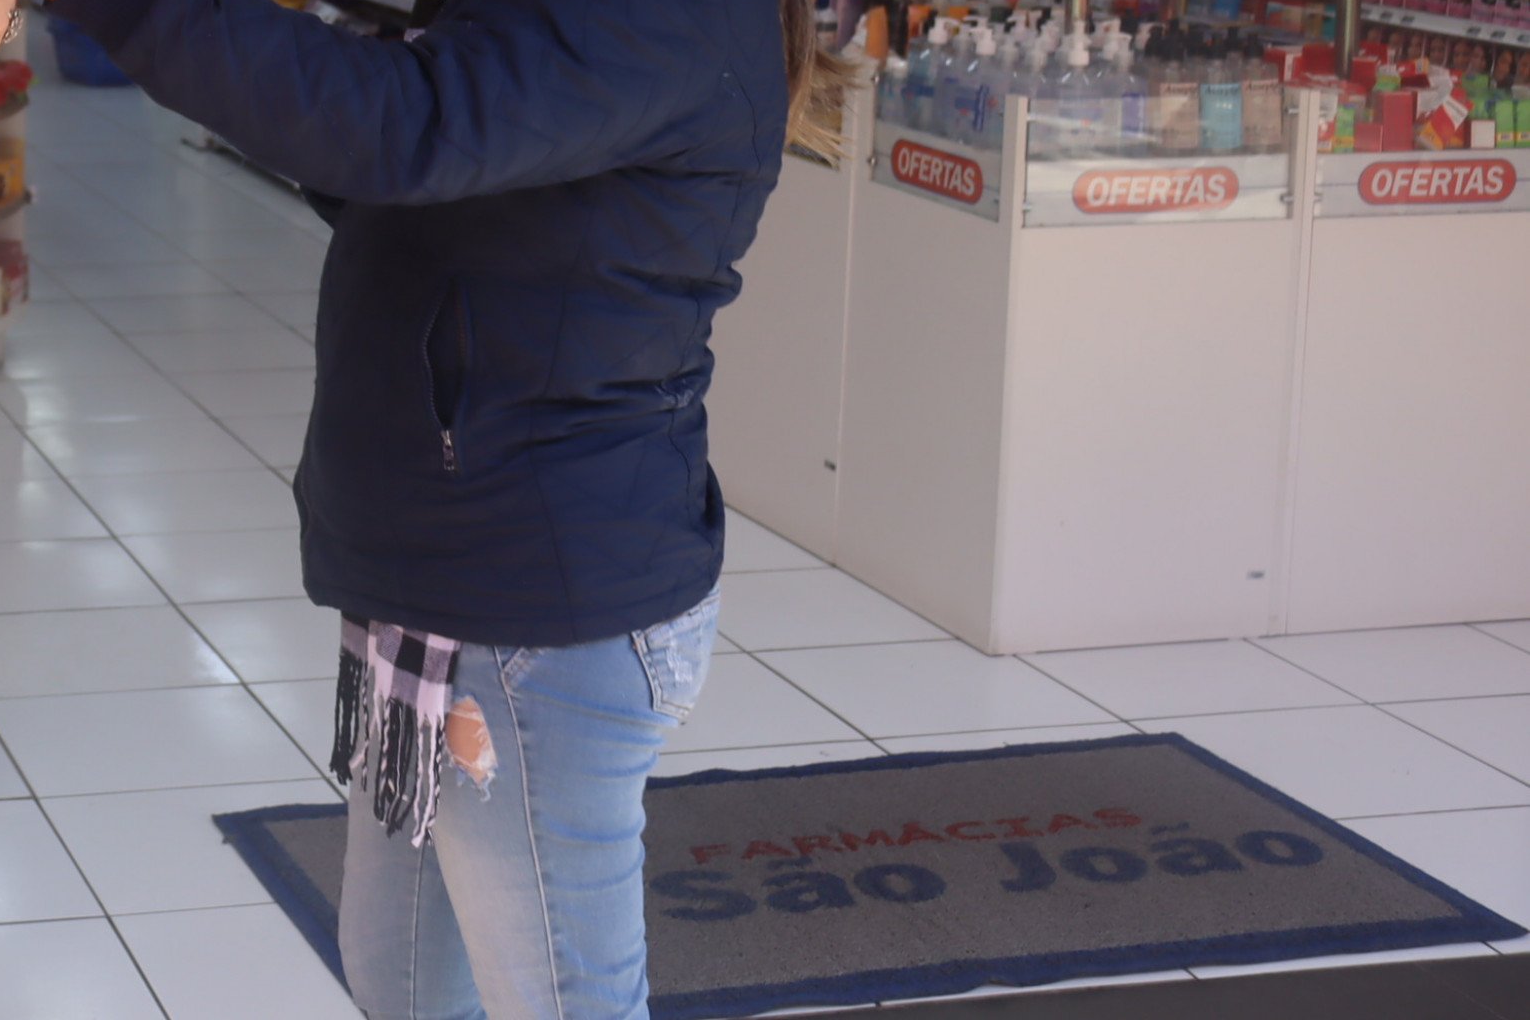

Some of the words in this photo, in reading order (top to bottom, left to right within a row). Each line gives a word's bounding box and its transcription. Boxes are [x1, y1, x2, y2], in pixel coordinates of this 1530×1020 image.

[897, 146, 976, 197] OFERTAS
[1084, 173, 1228, 208] OFERTAS
[1371, 165, 1505, 198] OFERTAS
[647, 855, 949, 922] São
[997, 821, 1326, 894] João
